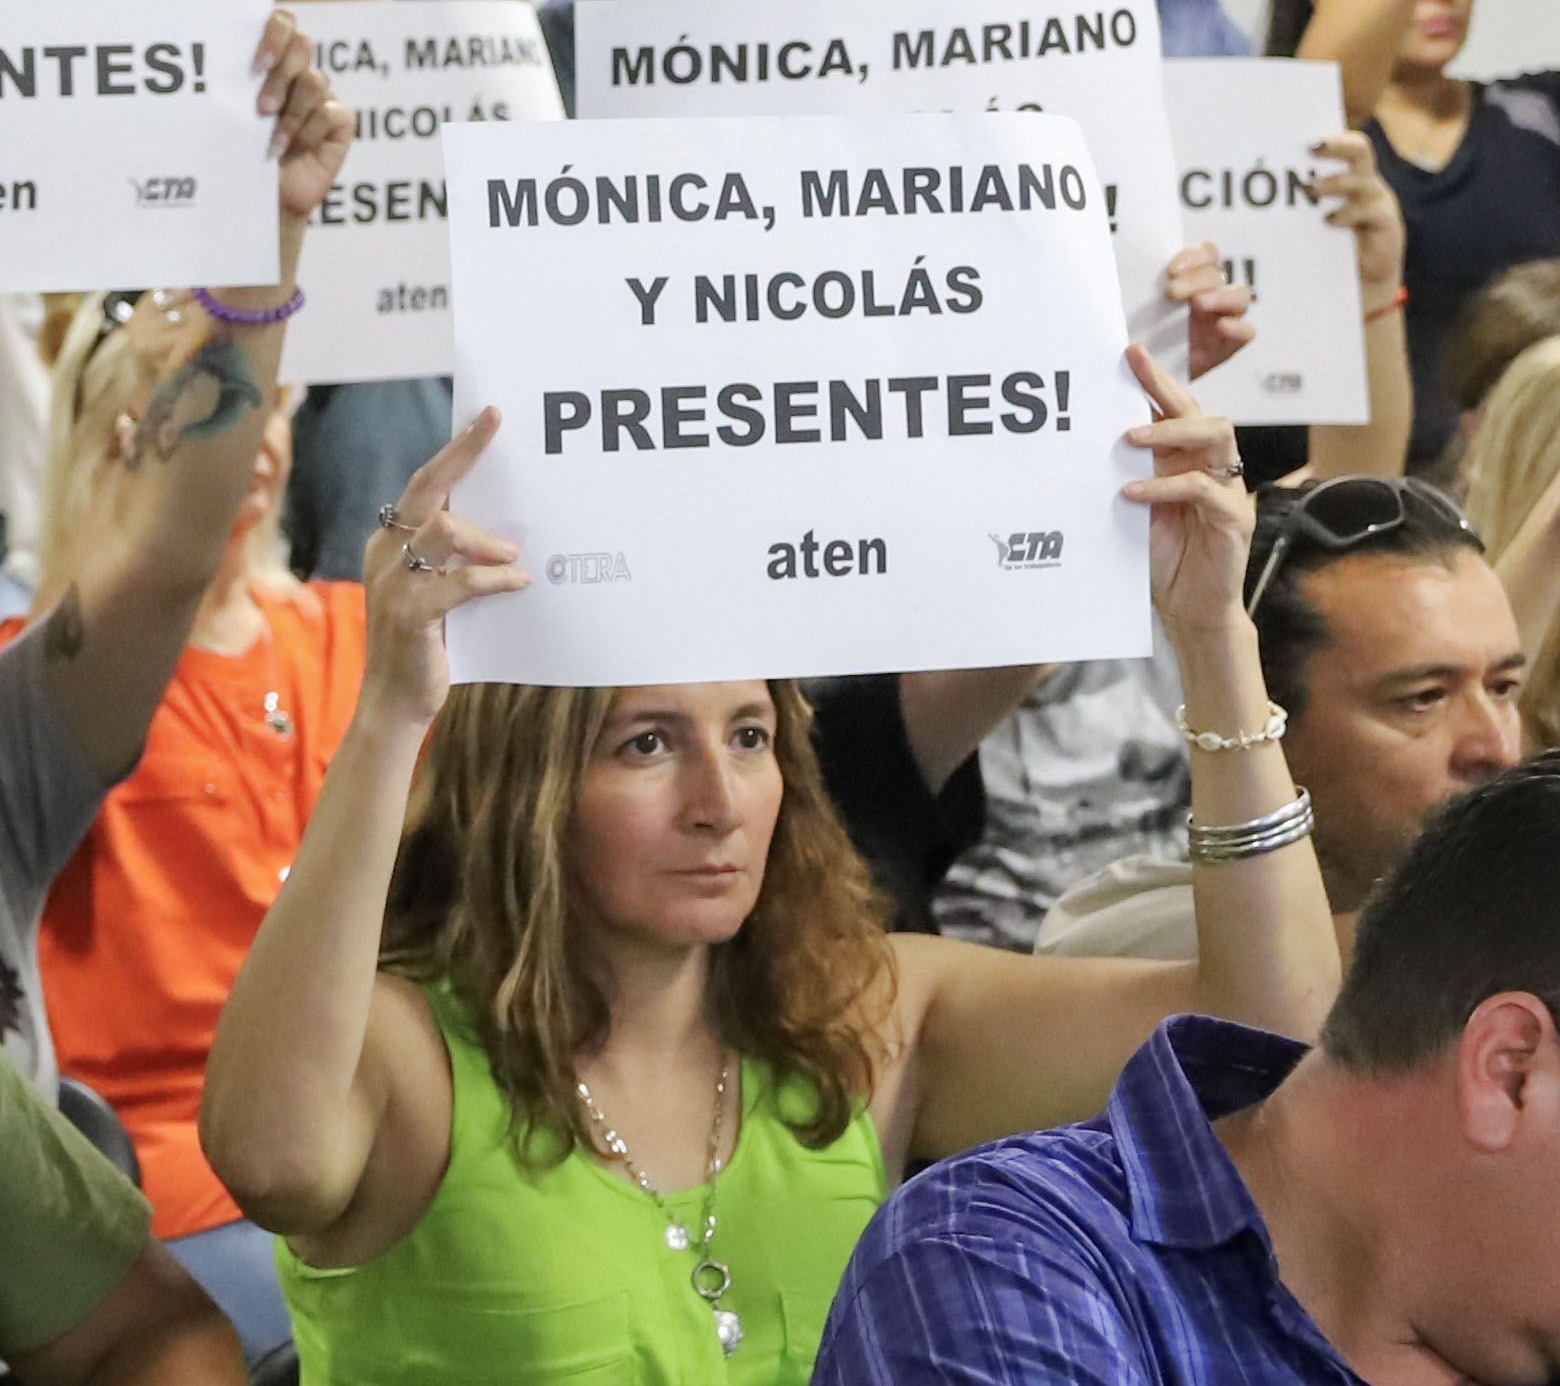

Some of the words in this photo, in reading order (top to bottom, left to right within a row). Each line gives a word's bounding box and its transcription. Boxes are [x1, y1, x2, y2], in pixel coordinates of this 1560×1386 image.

[612, 34, 868, 87] MÓNICA,
[892, 9, 1136, 70] MARIANO
[487, 164, 775, 232] MÓNICA,
[800, 164, 1086, 218] MARIANO
[377, 283, 450, 315] aten
[625, 277, 669, 325] Y
[695, 255, 983, 323] NICOLÁS
[543, 370, 1070, 455] PRESENTES!
[767, 529, 887, 580] aten
[1007, 530, 1063, 561] CTA
